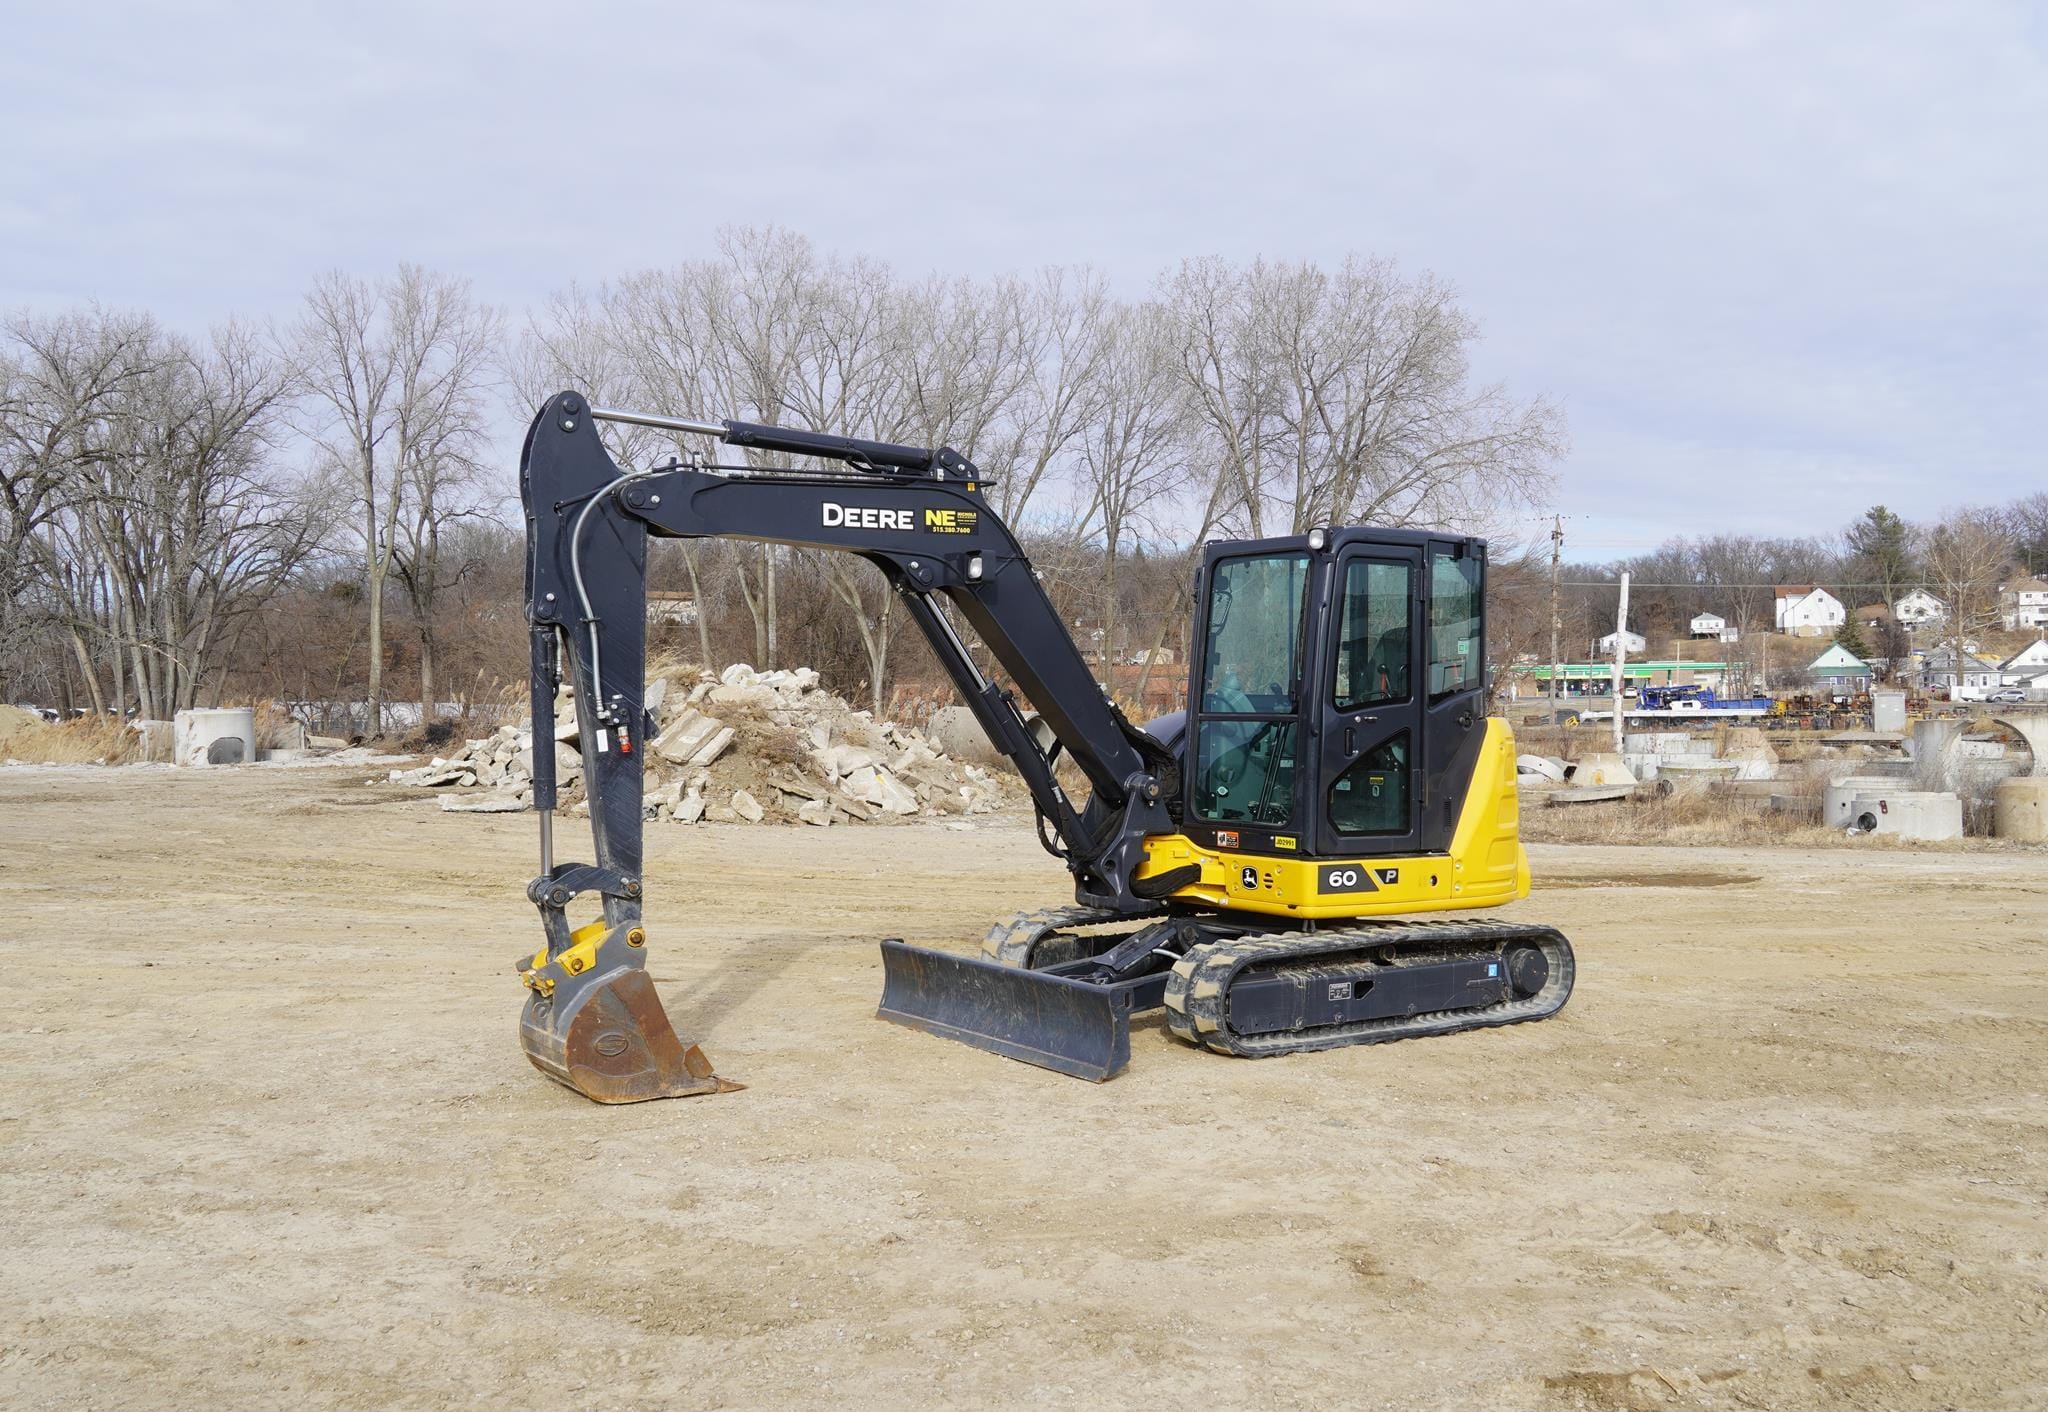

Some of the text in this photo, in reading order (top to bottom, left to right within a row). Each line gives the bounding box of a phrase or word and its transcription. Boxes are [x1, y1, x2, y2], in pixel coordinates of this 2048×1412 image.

[823, 503, 913, 530] DEERE
[925, 509, 956, 526] NE
[1329, 870, 1397, 887] 60 P
